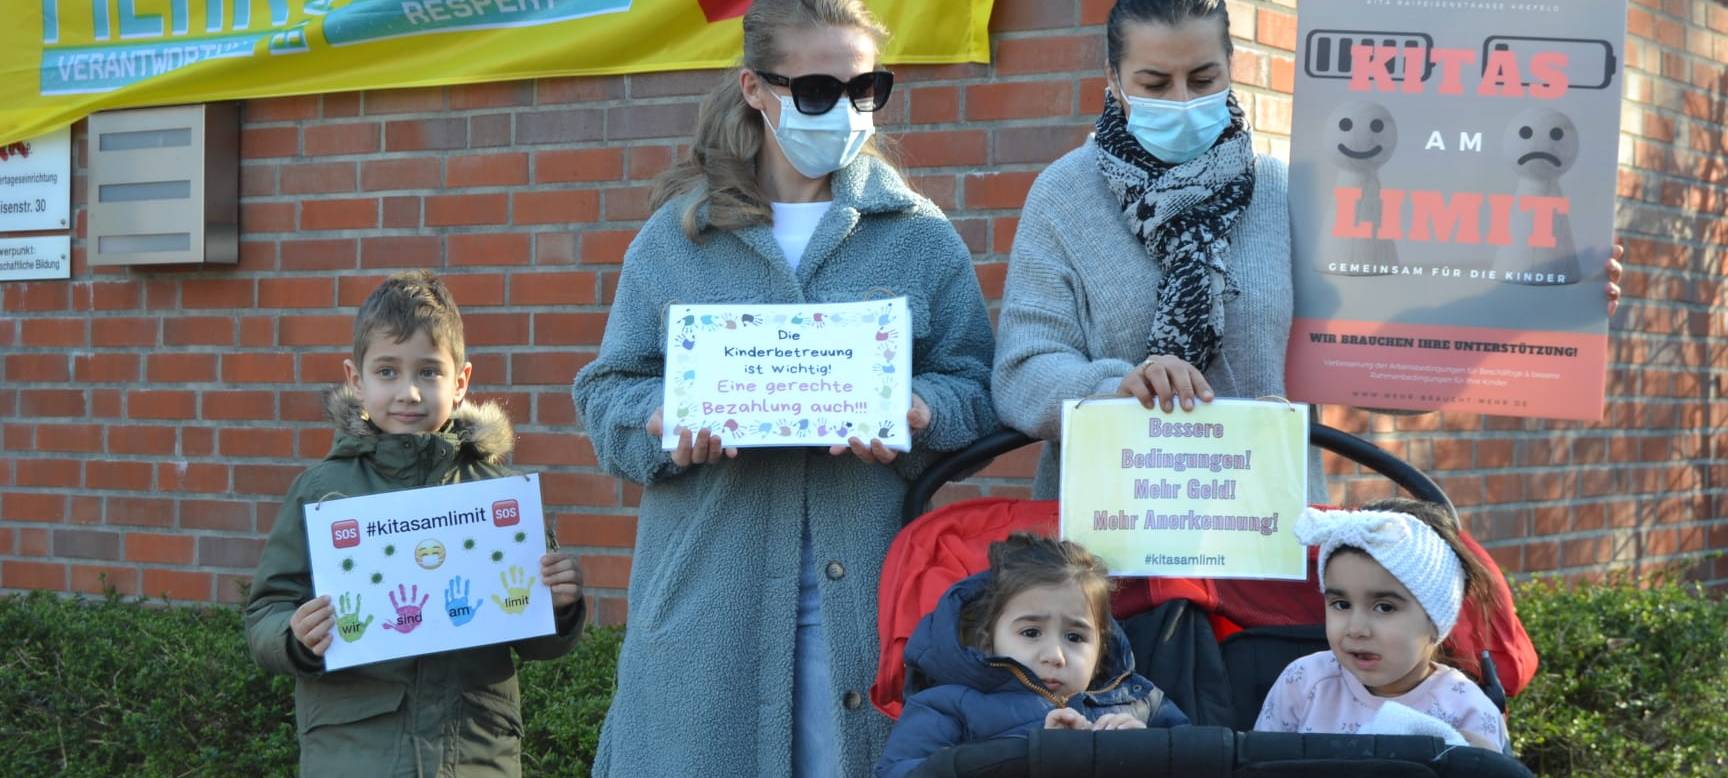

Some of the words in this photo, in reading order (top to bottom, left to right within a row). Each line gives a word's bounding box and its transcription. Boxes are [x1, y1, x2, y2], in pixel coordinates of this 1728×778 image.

[57, 40, 248, 82] VERANTWORT
[1349, 45, 1569, 100] KITAS
[1425, 131, 1483, 152] AM
[35, 199, 46, 212] 30
[1331, 187, 1569, 248] LIMIT
[35, 258, 60, 271] Bildung
[1328, 263, 1424, 276] GEMEINSAM
[1432, 265, 1461, 278] FÜR
[1470, 269, 1497, 280] DIE
[1505, 271, 1567, 284] KINDER
[778, 329, 801, 340] Die
[1310, 332, 1336, 343] WIR
[1341, 335, 1414, 348] BRAUCHEN
[1418, 338, 1450, 350] IHRE
[1454, 341, 1578, 357] UNTERSTÜTZUNG!
[724, 346, 854, 359] Kinderbetreuung
[744, 363, 765, 374] ist
[717, 379, 757, 393] Eine
[766, 379, 854, 395] gerechte
[702, 399, 802, 415] Bezahlung
[810, 400, 868, 414] auch!!!
[1149, 417, 1225, 438] Bessere
[1121, 449, 1252, 472] Bedingungen!
[1134, 479, 1181, 499] Mehr
[1187, 478, 1236, 500] Geld!
[334, 528, 358, 541] SOS
[366, 507, 487, 537] #kitasamlimit
[494, 507, 518, 520] SOS
[1093, 510, 1139, 531] Mehr
[1144, 510, 1279, 536] Anerkennung!
[1144, 554, 1226, 566] #kitasamlimit
[342, 622, 361, 635] wir
[396, 612, 423, 626] sind
[448, 605, 471, 617] am
[504, 595, 530, 608] limit
